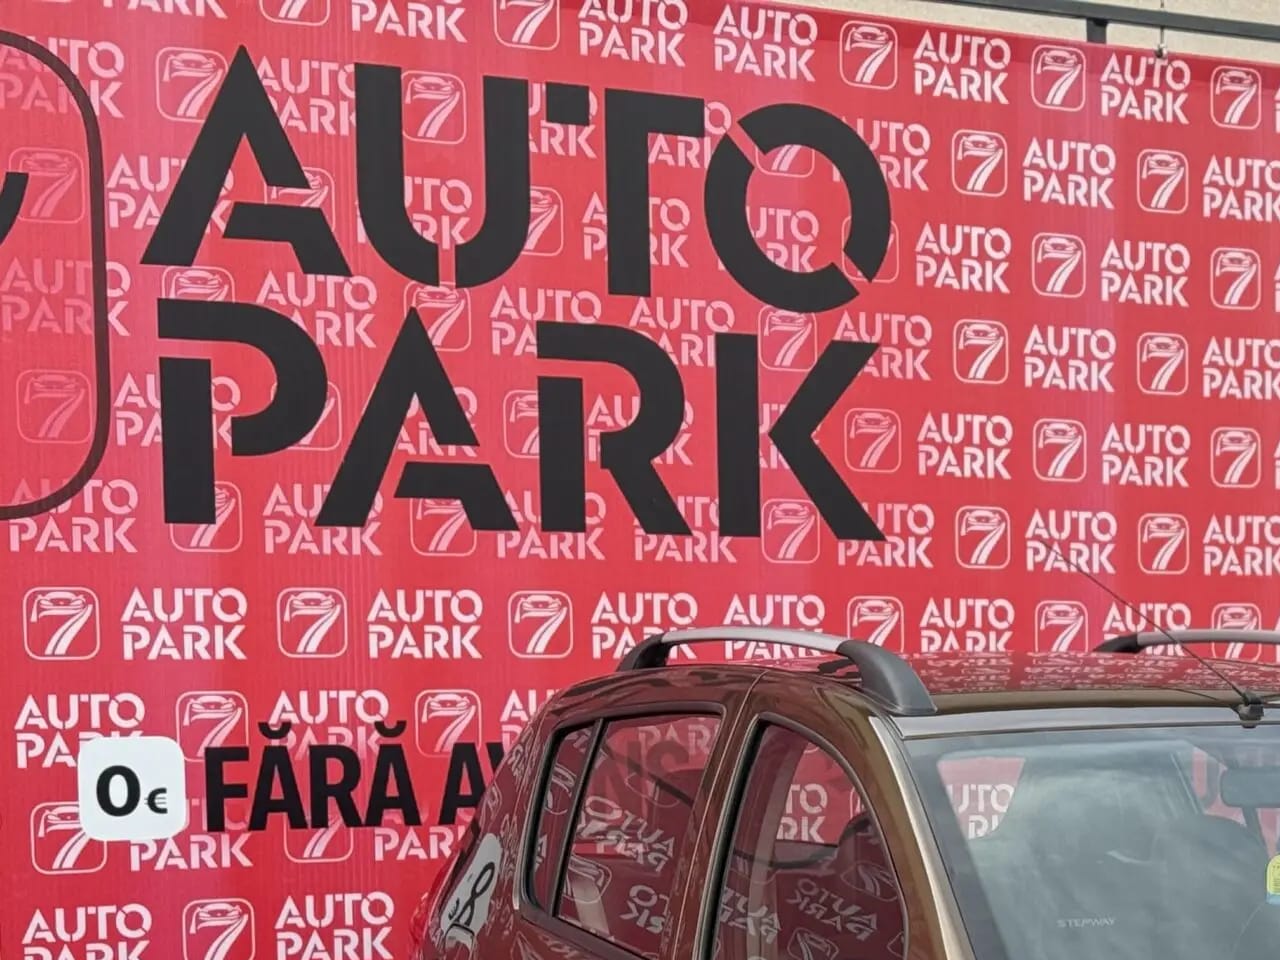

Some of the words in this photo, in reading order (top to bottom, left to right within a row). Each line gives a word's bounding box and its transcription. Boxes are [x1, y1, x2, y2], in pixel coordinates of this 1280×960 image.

[351, 0, 467, 43] PARK
[578, 0, 687, 30] AUTO
[713, 5, 817, 46] AUTO
[580, 21, 685, 67] PARK
[715, 38, 815, 82] PARK
[914, 32, 1010, 69] AUTO
[914, 62, 1009, 104] PARK
[1101, 54, 1190, 90] AUTO
[1101, 85, 1189, 124] PARK
[841, 116, 931, 156] UTO
[1023, 138, 1116, 176] AUTO
[140, 45, 892, 313] AUTO
[1024, 170, 1114, 209] PARK
[915, 222, 1011, 259] AUTO
[1101, 239, 1190, 274] AUTO
[256, 270, 377, 310] AUTO
[916, 255, 1010, 293] PARK
[1102, 271, 1188, 307] PARK
[489, 286, 602, 324] AUTO
[629, 296, 735, 333] AUTO
[833, 310, 932, 347] AUTO
[1024, 325, 1116, 360] AUTO
[1025, 356, 1114, 392] PARK
[157, 296, 886, 541] PARK
[918, 412, 1013, 446] AUTO
[1101, 423, 1190, 455] AUTO
[919, 445, 1011, 480] PARK
[1102, 454, 1188, 487] PARK
[9, 516, 138, 553] PARK
[1025, 509, 1117, 542] AUTO
[497, 527, 605, 561] PARK
[634, 534, 738, 564] PARK
[838, 535, 934, 568] PARK
[1027, 541, 1115, 574] PARK
[121, 588, 247, 622] AUTO
[367, 589, 483, 623] AUTO
[591, 592, 698, 625] AUTO
[723, 595, 826, 627] AUTO
[919, 598, 1015, 630] AUTO
[1102, 602, 1192, 633] AUTO
[123, 625, 246, 660] PARK
[369, 624, 482, 659] PARK
[15, 692, 146, 730] AUTO
[269, 690, 390, 725] AUTO
[204, 719, 423, 833] FĂRĂ
[130, 833, 254, 871] PARK
[374, 826, 467, 861] PAR
[22, 903, 152, 944] AUTO
[275, 891, 394, 929] AUTO
[1056, 916, 1117, 929] STEPWAY
